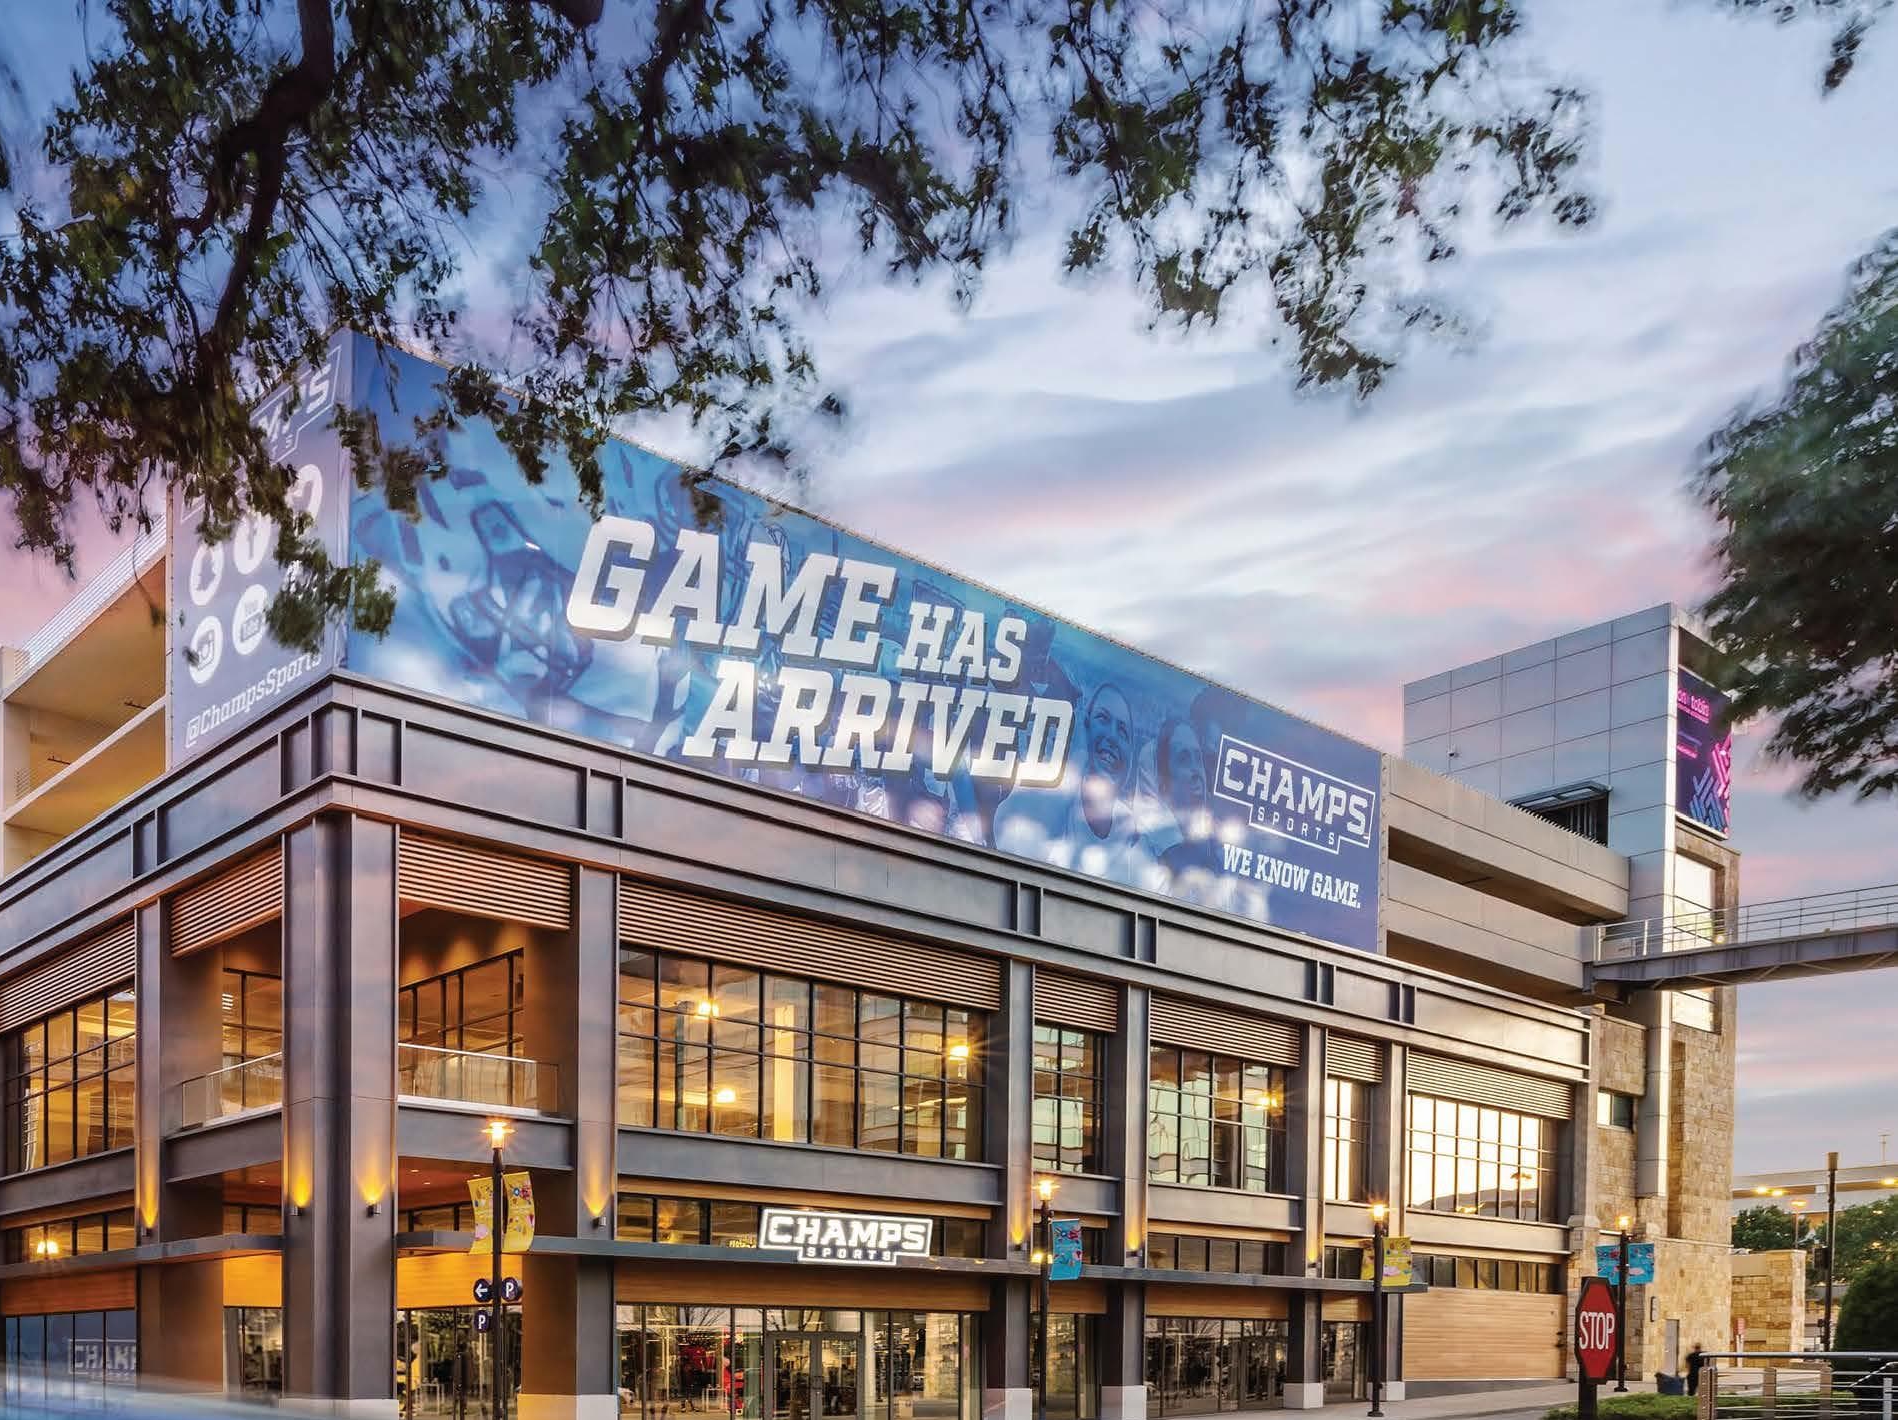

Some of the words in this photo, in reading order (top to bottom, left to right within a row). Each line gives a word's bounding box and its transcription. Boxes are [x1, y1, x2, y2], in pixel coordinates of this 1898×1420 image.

[566, 515, 898, 667] GAME
[895, 602, 1028, 684] HAS
[682, 659, 1075, 785] ARRIVED
[1223, 748, 1368, 836] CHAMPS
[1257, 806, 1335, 846] SPORTS
[1223, 843, 1253, 877] WE
[1255, 853, 1310, 893] KNOW
[1311, 872, 1361, 909] GAME.
[767, 1215, 927, 1251] CHAMPS
[806, 1246, 892, 1262] SPORTS
[505, 1282, 514, 1298] P
[478, 1314, 486, 1330] P
[1579, 1311, 1615, 1350] STOP
